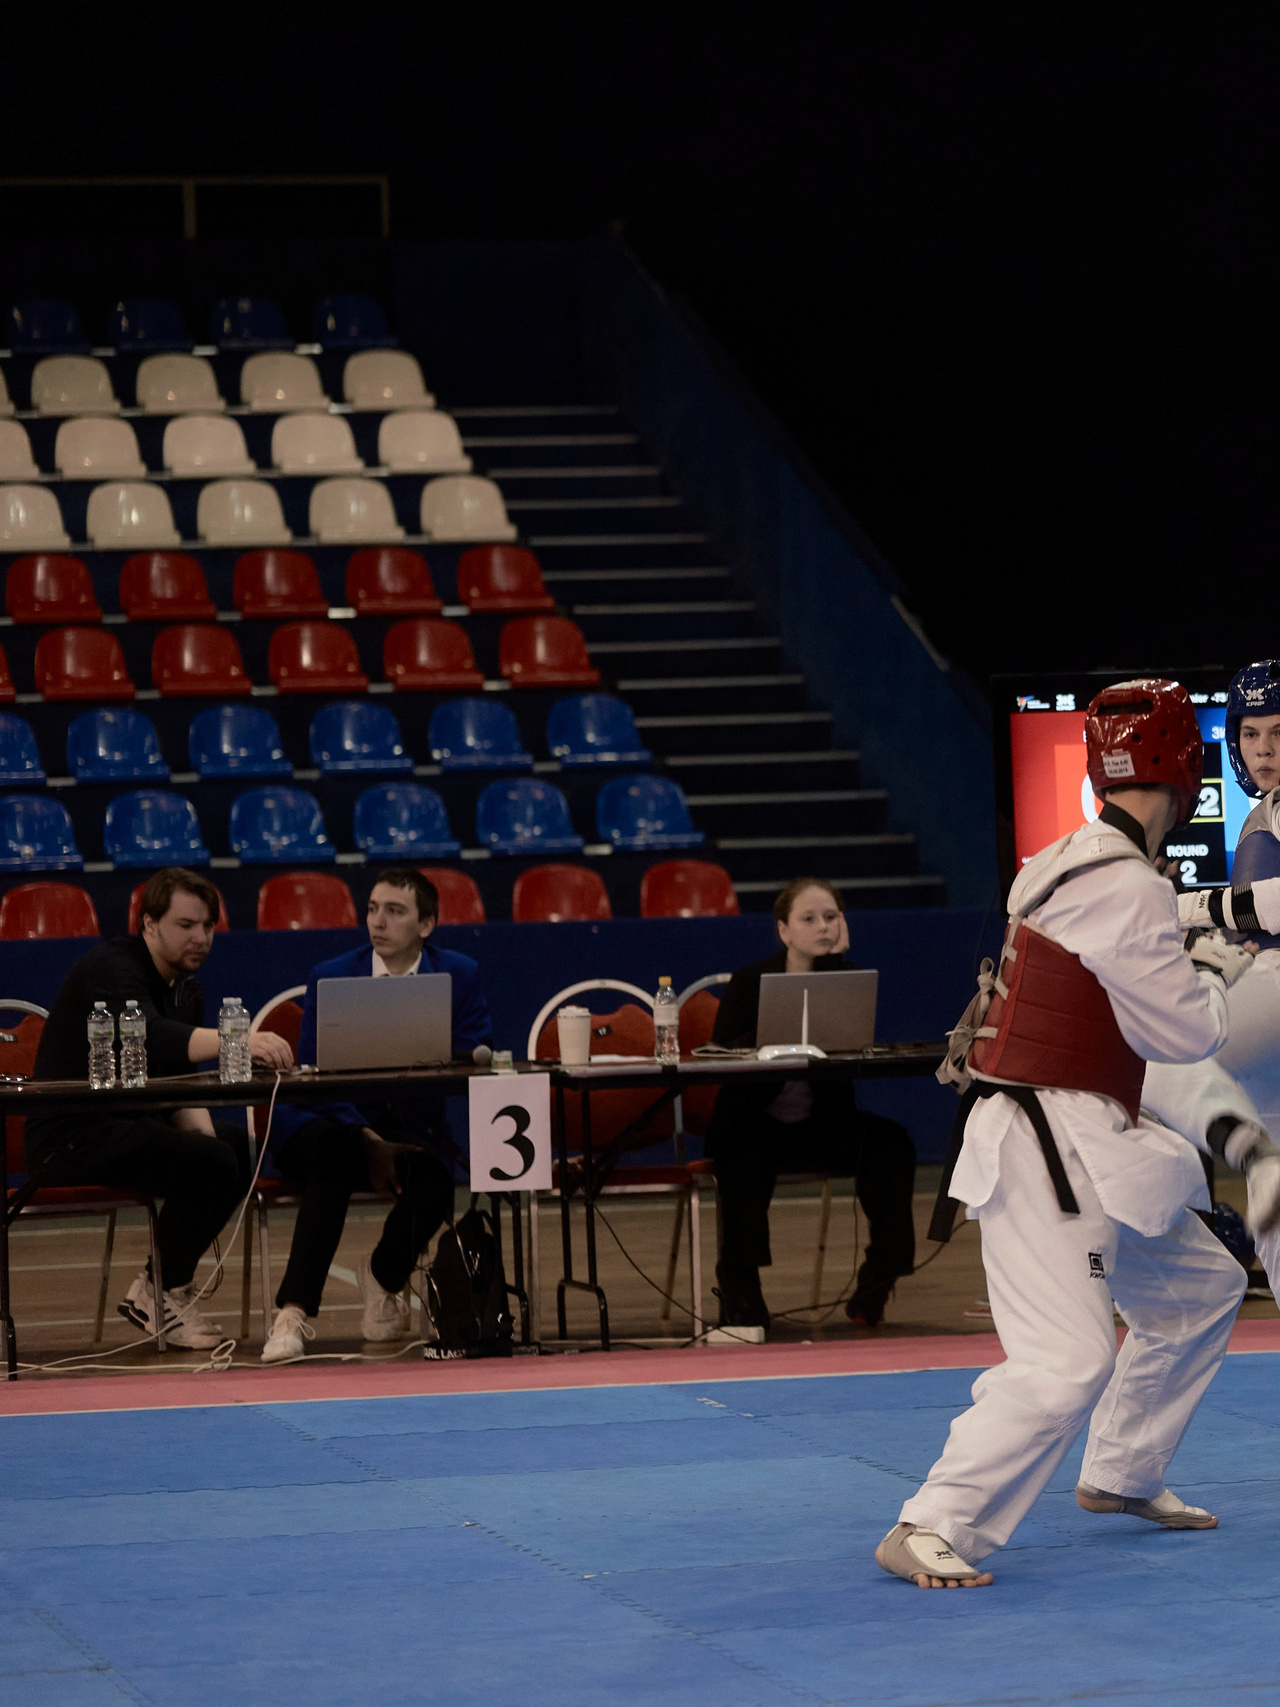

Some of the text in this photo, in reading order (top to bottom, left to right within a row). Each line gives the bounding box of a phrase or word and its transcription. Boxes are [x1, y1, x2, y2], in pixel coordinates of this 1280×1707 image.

[1193, 786, 1220, 816] 2
[1166, 844, 1209, 858] ROUND
[1180, 860, 1198, 884] 2
[489, 1104, 536, 1181] 3
